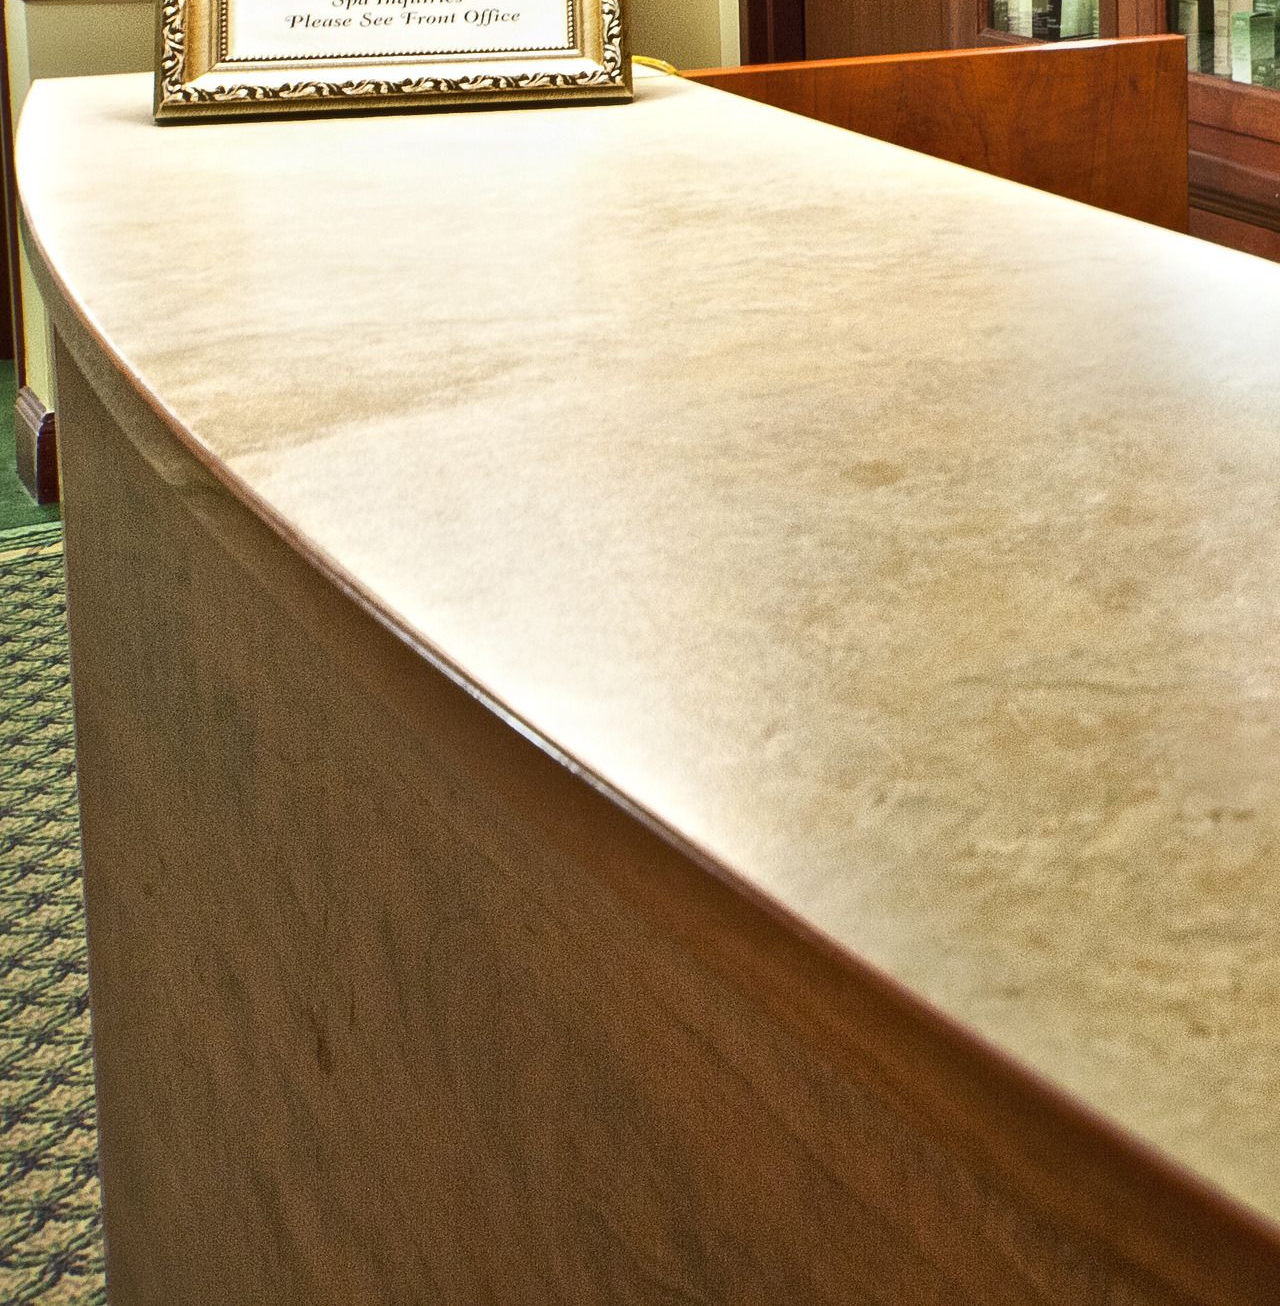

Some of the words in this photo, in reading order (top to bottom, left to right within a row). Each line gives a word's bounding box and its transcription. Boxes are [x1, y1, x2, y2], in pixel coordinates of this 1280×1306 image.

[284, 13, 353, 30] Please
[359, 12, 394, 28] See
[400, 10, 457, 26] Front
[464, 8, 521, 27] Office
